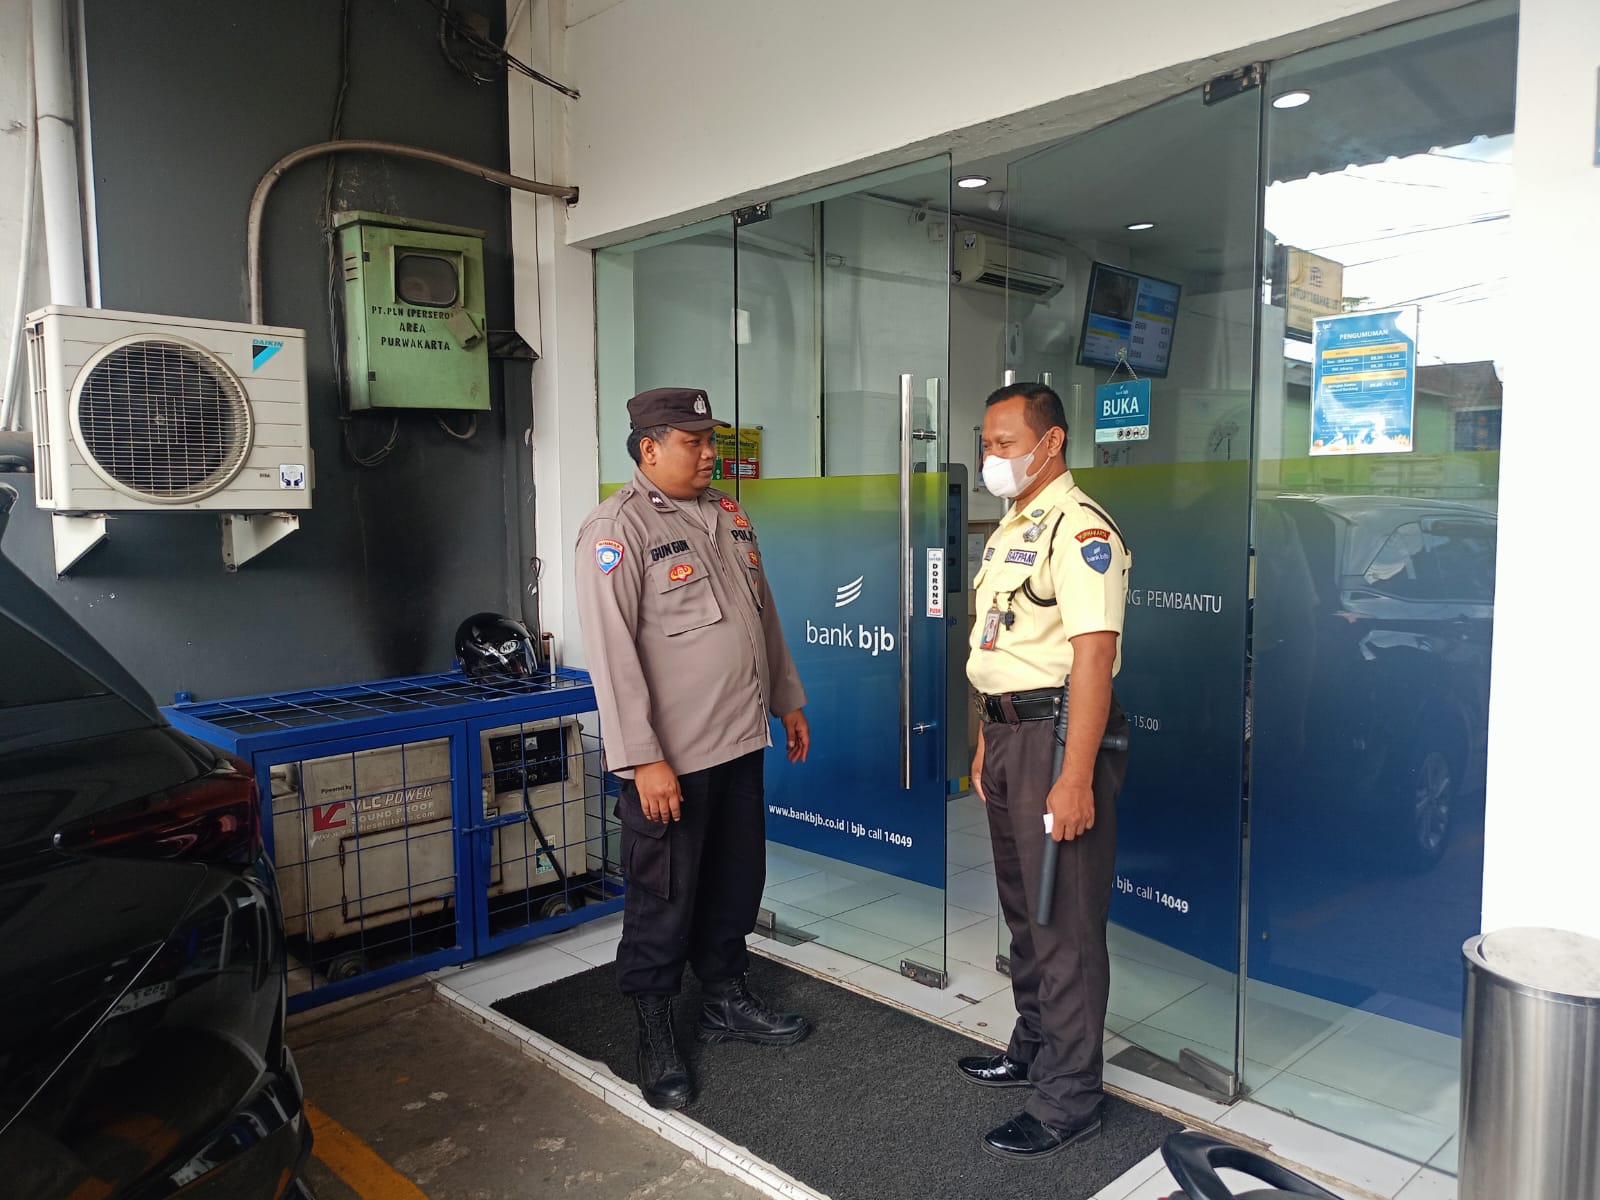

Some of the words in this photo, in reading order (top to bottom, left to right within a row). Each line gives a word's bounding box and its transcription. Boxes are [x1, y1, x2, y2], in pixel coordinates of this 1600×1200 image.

[399, 322, 426, 333] AREA
[252, 338, 284, 348] DAIKIN
[381, 336, 450, 351] PURWAKARTA
[1103, 396, 1139, 416] BUKA
[1147, 590, 1222, 614] PEMBANTU
[806, 619, 854, 648] bank
[858, 624, 895, 657] bjb
[1134, 715, 1159, 731] 15.00
[384, 785, 433, 805] POWER
[351, 810, 392, 825] SOUND
[768, 803, 845, 832] www.bankbjb.co.id
[851, 822, 866, 838] bjb
[868, 828, 882, 841] call
[884, 830, 912, 848] 14049
[1116, 875, 1133, 894] bjb
[1136, 886, 1153, 900] call
[1155, 890, 1189, 913] 14049
